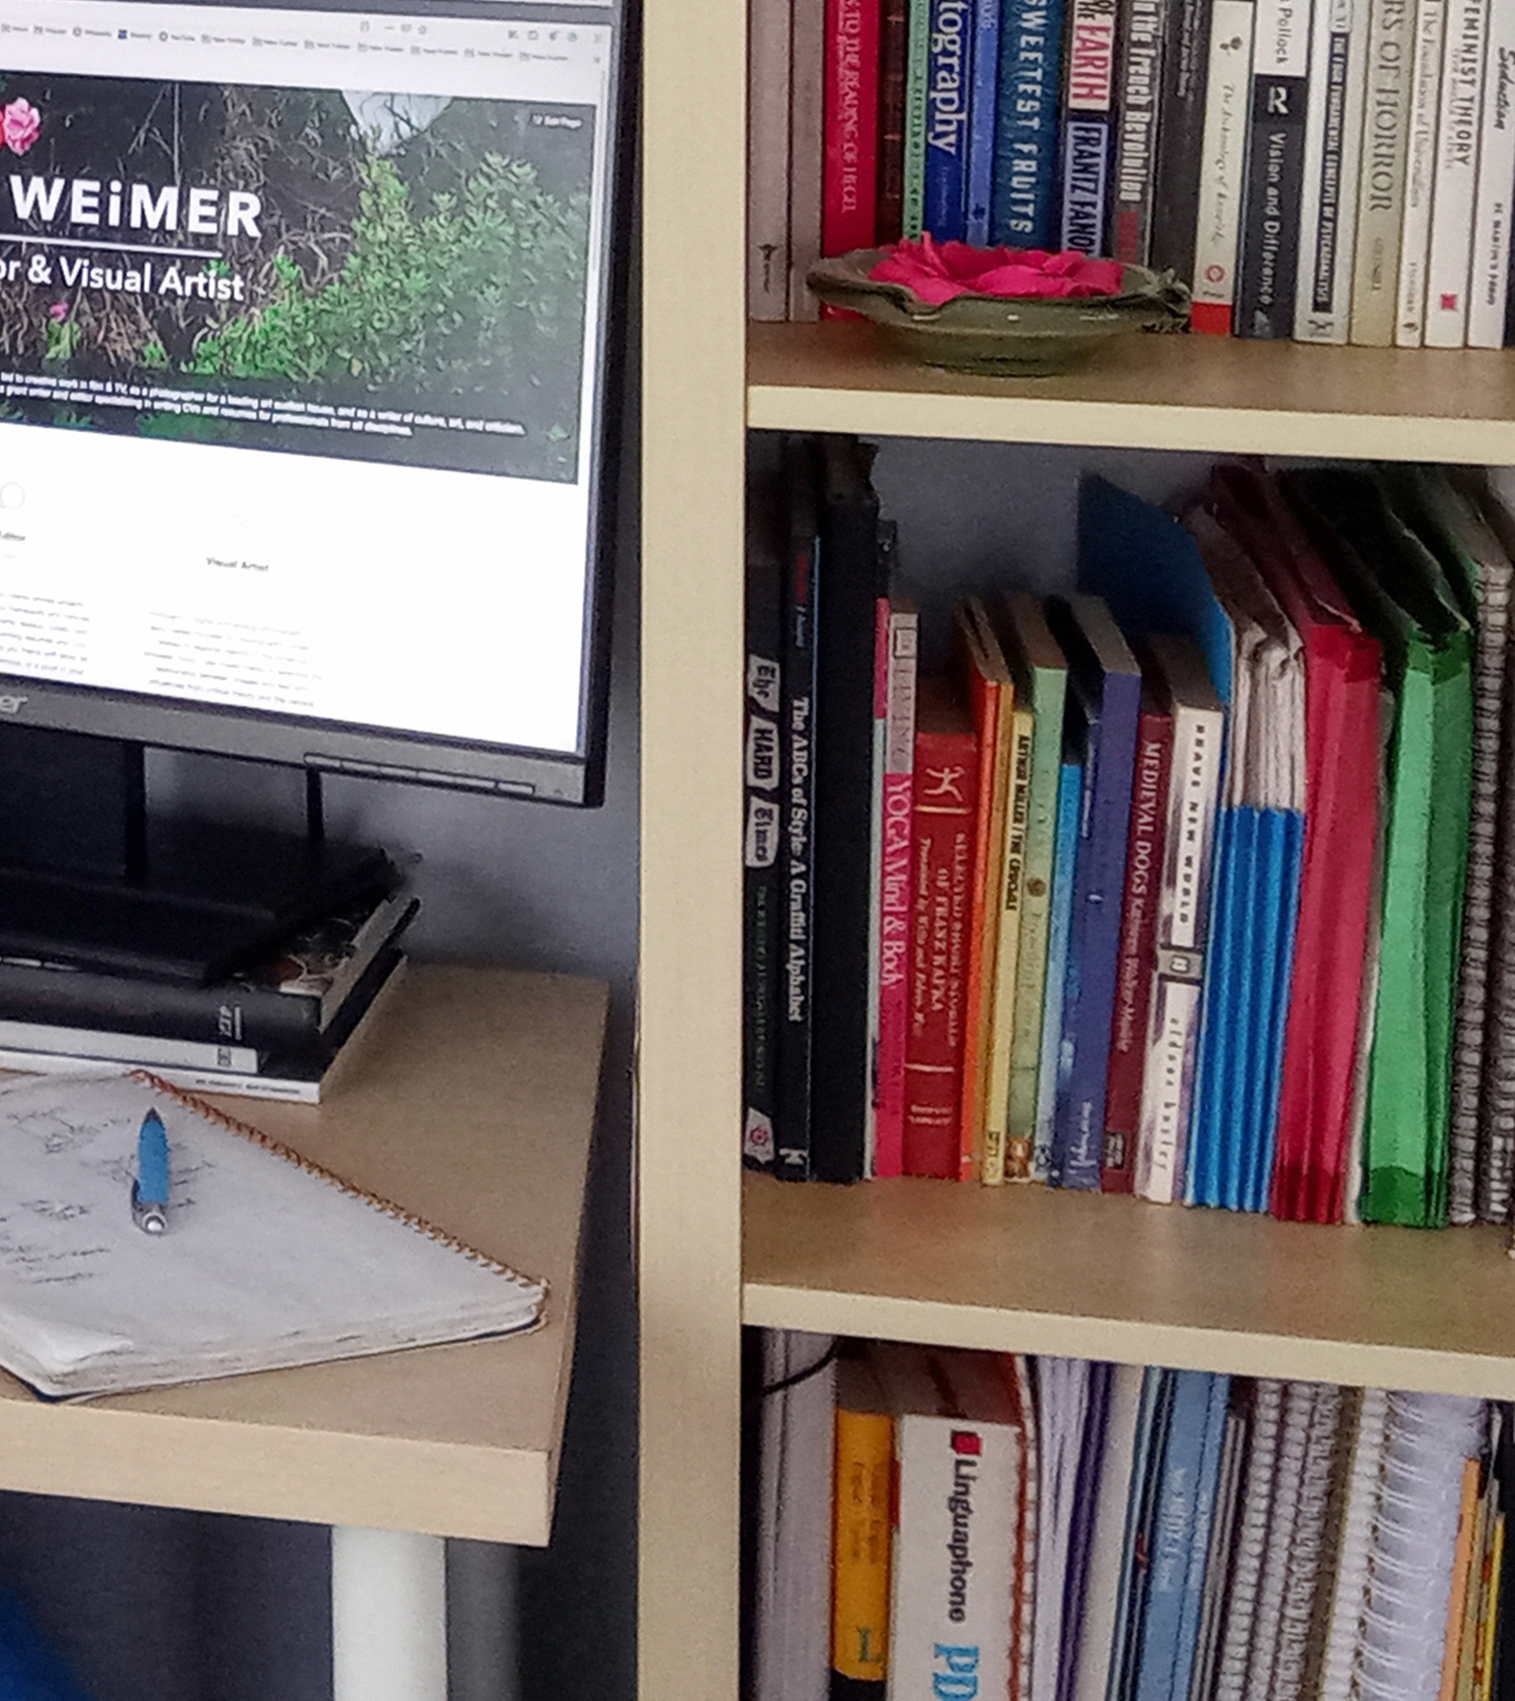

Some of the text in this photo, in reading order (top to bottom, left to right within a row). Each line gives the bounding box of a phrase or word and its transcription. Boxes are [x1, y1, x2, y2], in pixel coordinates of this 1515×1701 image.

[845, 10, 860, 34] TO
[1129, 15, 1162, 42] the
[1275, 7, 1294, 65] Pollock
[1423, 9, 1437, 34] The
[845, 38, 861, 67] THE
[1071, 24, 1111, 101] EARTH
[1126, 47, 1156, 105] French
[1377, 41, 1401, 79] OF
[843, 70, 859, 137] READING
[1494, 47, 1515, 130] Seduction
[842, 143, 857, 164] OF
[1120, 110, 1152, 202] Revolution
[1369, 87, 1400, 212] HORROR
[1455, 95, 1476, 166] THEORY
[1070, 125, 1103, 195] FRANTZ
[1316, 36, 1349, 303] THE FOUR FUNDAMENTAL CONCEPTS OF PSYCHOANALYSIS
[9, 173, 263, 238] WEiMER
[841, 166, 857, 213] HEGEL
[1009, 142, 1039, 234] FRUITS
[1259, 132, 1287, 305] Vision and Difference
[27, 255, 53, 286] &
[59, 256, 151, 294] Visual
[158, 265, 245, 302] Artist
[752, 664, 777, 699] The
[792, 696, 809, 731] The
[753, 727, 775, 780] HARD
[791, 734, 809, 785] ABCs
[1016, 734, 1030, 781] ARTHUR
[791, 787, 808, 806] of
[885, 780, 911, 854] YOGA
[1012, 784, 1028, 824] MILLER
[1132, 741, 1161, 894] MEDIEVAL DOGS
[1180, 724, 1206, 924] BRAVE NEW WORLD
[754, 807, 774, 862] Times
[1010, 835, 1023, 854] THE
[790, 859, 807, 875] A
[882, 856, 908, 911] Mind
[1006, 858, 1022, 912] CRUCIBLE
[789, 879, 807, 940] Graffiti
[882, 915, 906, 935] &
[916, 898, 929, 912] by
[930, 868, 949, 1011] OF FRANZ KAFKA
[785, 944, 806, 1022] Alphabet
[946, 1458, 978, 1623] Linguaphone
